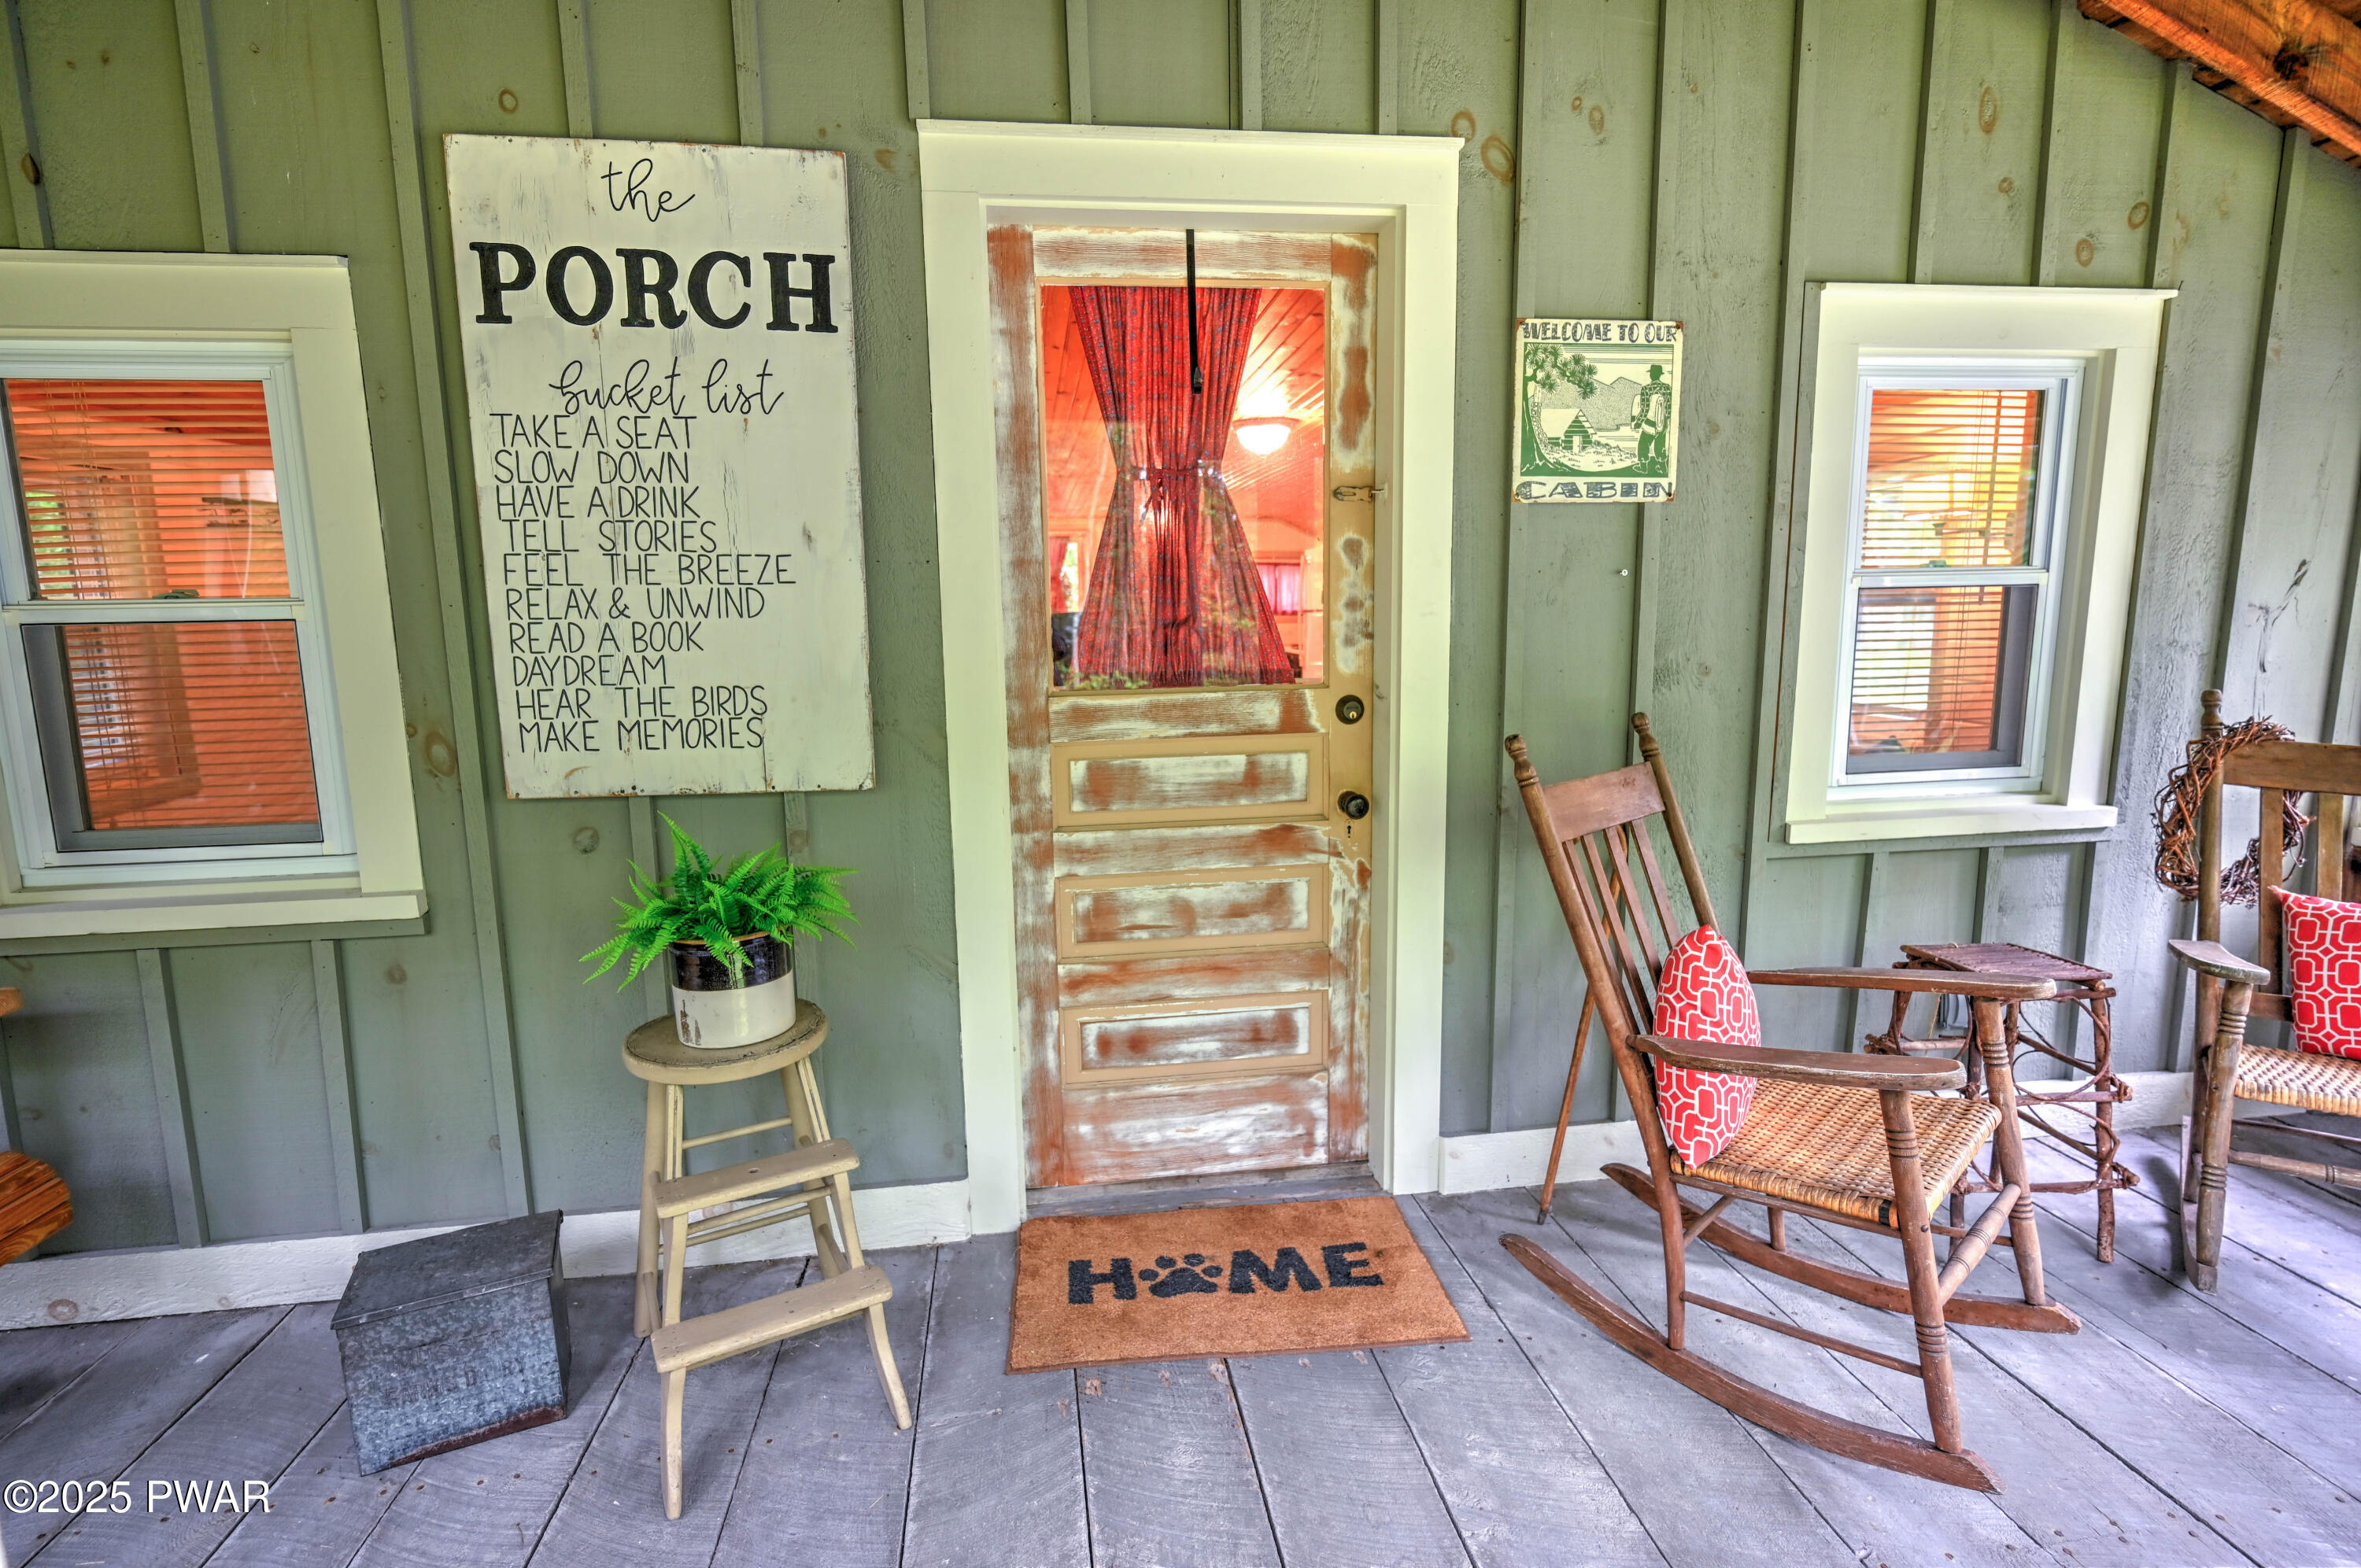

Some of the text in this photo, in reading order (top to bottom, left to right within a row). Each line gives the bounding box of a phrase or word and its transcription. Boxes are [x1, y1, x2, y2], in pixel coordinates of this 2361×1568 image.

[601, 158, 696, 222] the
[469, 242, 838, 333] PORCH
[1523, 322, 1677, 343] WELCOME TO OUR
[549, 356, 784, 415] bucket list
[490, 413, 696, 449] TAKE A SEAT
[494, 450, 689, 484] SLOW DOWN
[497, 485, 700, 521] HAVE A DRINK
[1516, 481, 1672, 500] CABIN
[501, 519, 717, 552] TELL STORIES
[503, 553, 796, 586] FEEL THE BREEZE
[506, 587, 765, 621] RELAX & UNWIND
[509, 622, 704, 654] READ A BOOK
[512, 655, 667, 687] DAYDREAM
[516, 685, 767, 721] HEAR THE BIRDS
[519, 718, 763, 753] MAKE MEMORIES
[1067, 1241, 1384, 1304] HME
